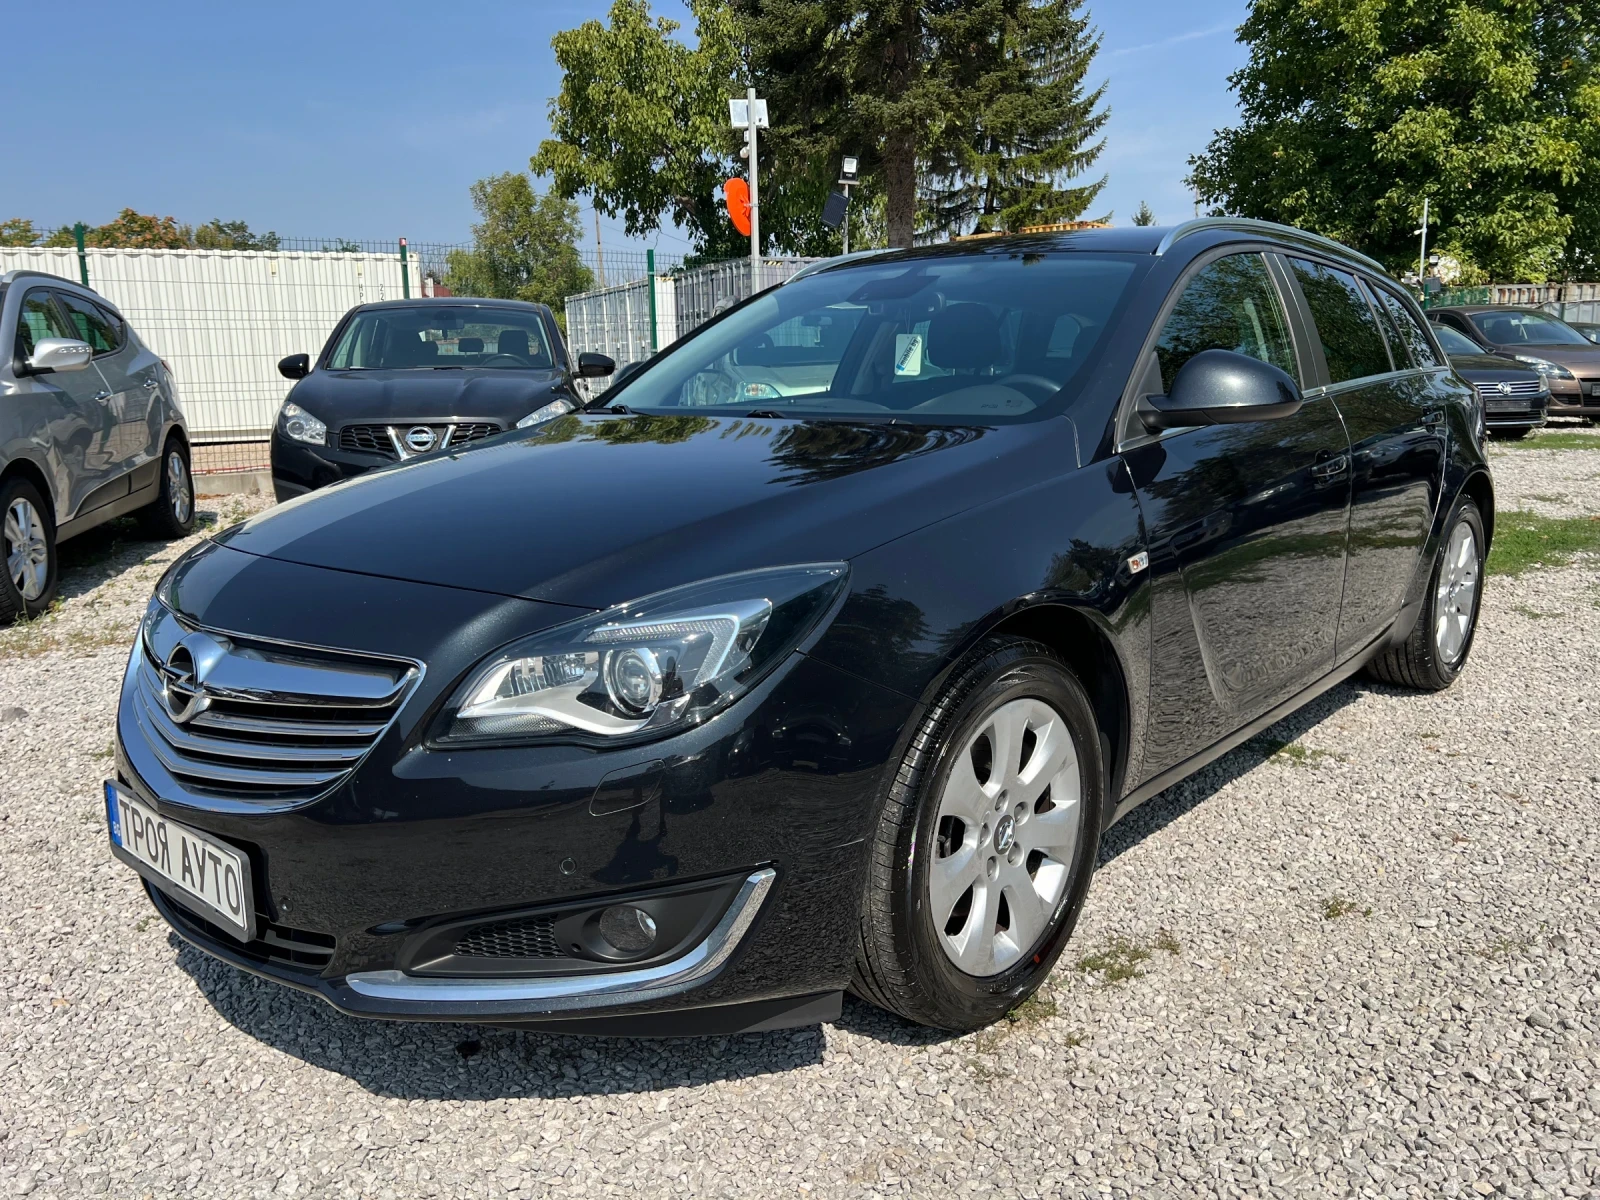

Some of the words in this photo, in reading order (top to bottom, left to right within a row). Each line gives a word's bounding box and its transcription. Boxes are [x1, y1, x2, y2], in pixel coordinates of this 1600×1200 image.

[406, 433, 436, 442] NISSAN
[112, 820, 121, 837] BG
[119, 798, 172, 875] ТРОЯ
[181, 835, 241, 916] АУТО
